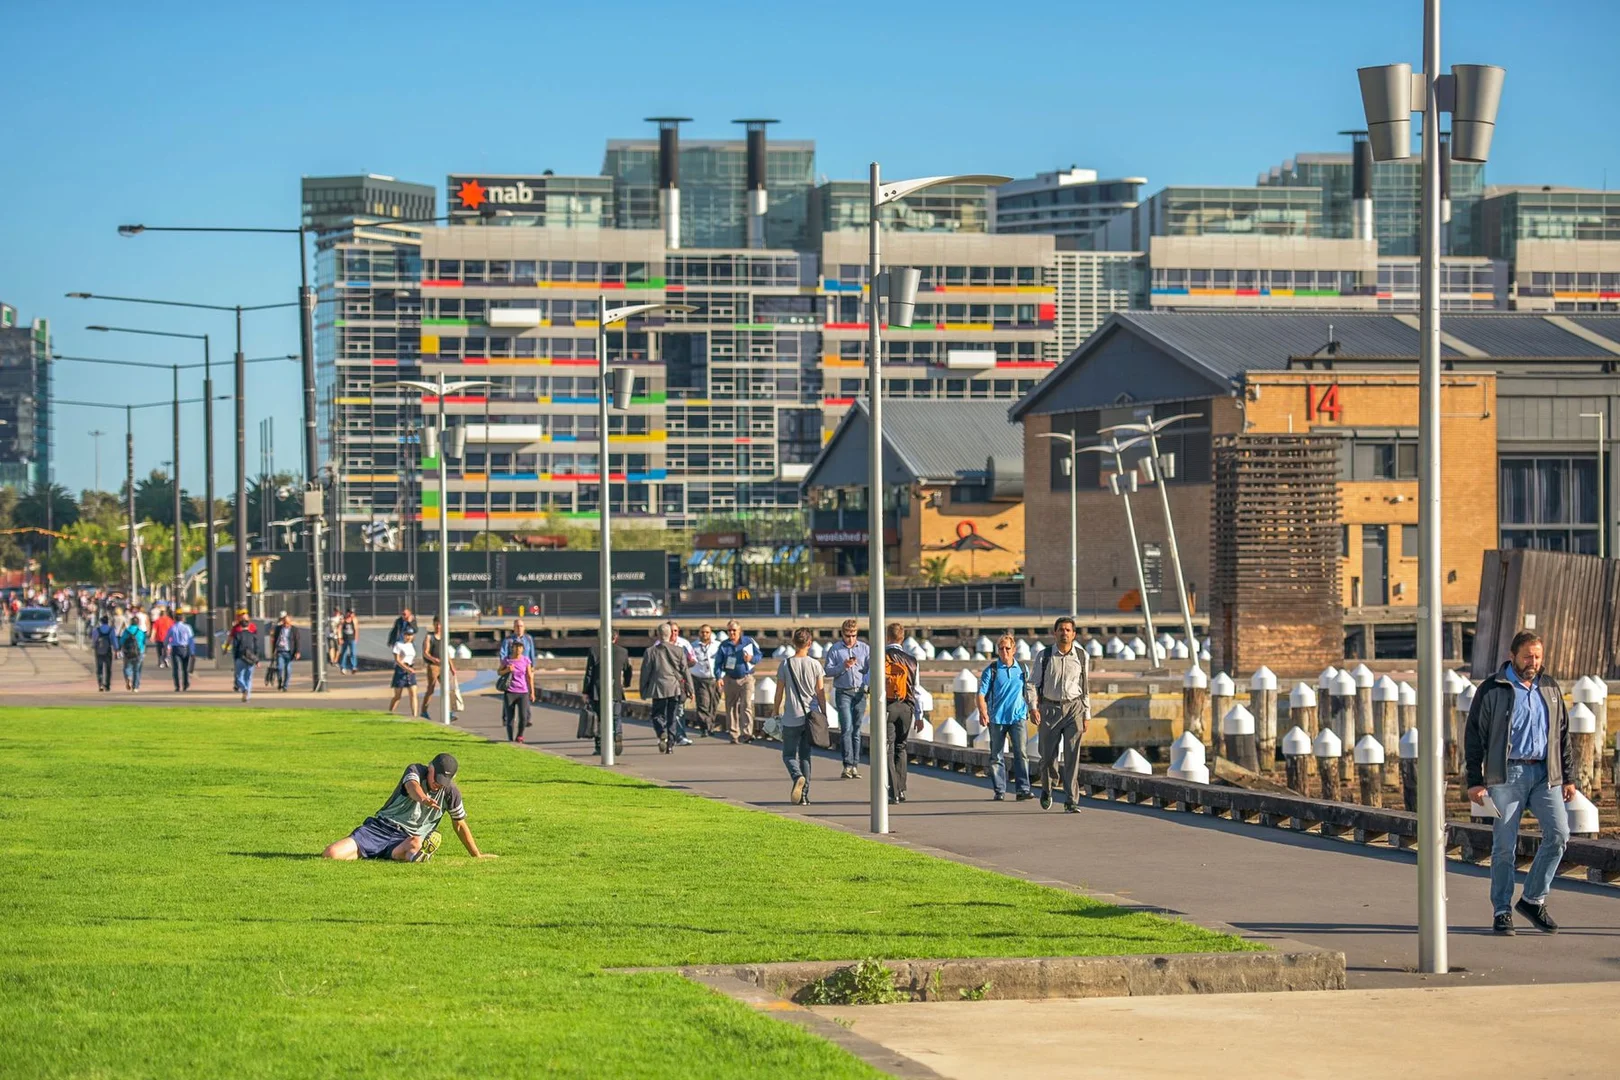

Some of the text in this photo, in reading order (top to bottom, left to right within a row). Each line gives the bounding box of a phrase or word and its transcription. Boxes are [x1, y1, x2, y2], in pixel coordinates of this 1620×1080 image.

[487, 181, 534, 204] nab
[1306, 384, 1343, 421] 14
[815, 531, 861, 542] woolshed
